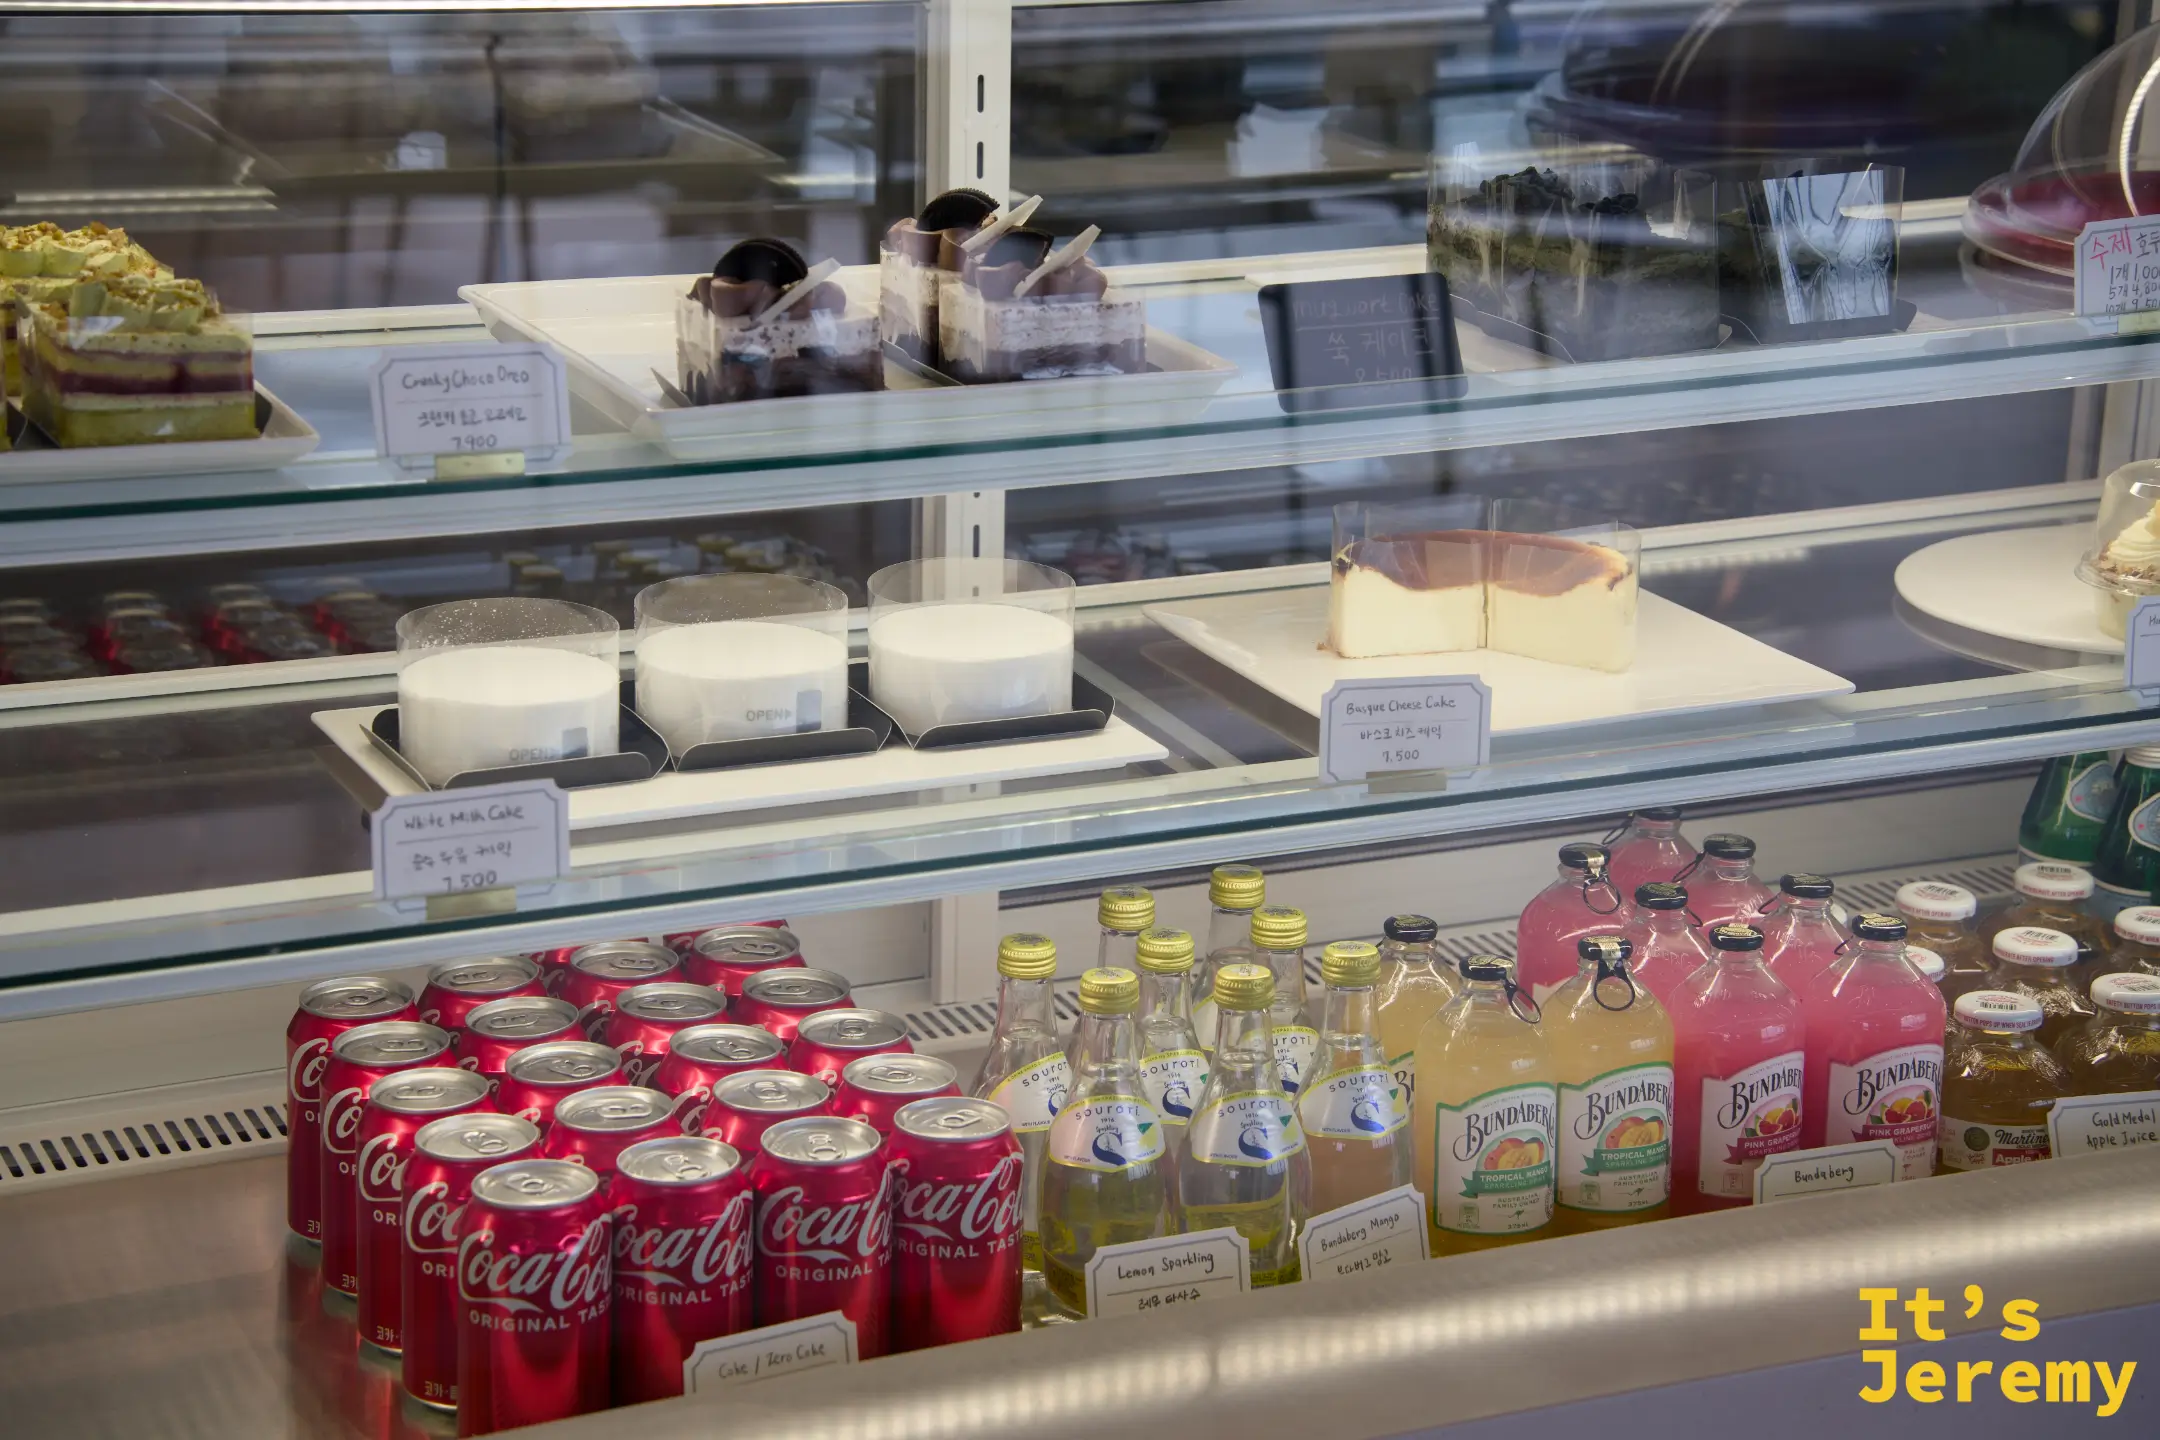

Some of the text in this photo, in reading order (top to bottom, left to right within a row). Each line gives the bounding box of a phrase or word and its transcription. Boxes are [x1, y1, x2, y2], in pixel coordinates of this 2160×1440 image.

[2090, 224, 2132, 271] 수제
[2134, 263, 2160, 282] 1,00
[2132, 281, 2160, 297] 4,80
[1324, 327, 1434, 366] 쑥 케이크
[497, 364, 530, 385] Oreo
[1346, 695, 1456, 716] Basque Cheese Cake
[746, 709, 783, 722] OPEN
[1360, 726, 1393, 741] 바스크
[1395, 726, 1416, 740] 치즈
[1382, 749, 1420, 763] 7.500
[404, 804, 524, 831] White Milk Cake
[1717, 1066, 1803, 1130] BUNDABER
[2091, 1108, 2156, 1128] Gold Medal
[1869, 1128, 1892, 1137] PINK
[2086, 1130, 2159, 1149] Apple Juice
[1744, 1140, 1765, 1149] PINK
[1601, 1152, 1645, 1161] TROPICAL
[1995, 1154, 2032, 1165] Apple
[1480, 1171, 1524, 1183] TROPICAL
[1794, 1164, 1854, 1183] Bundaberg
[1320, 1213, 1400, 1252] Bundaberg Mango
[775, 1263, 873, 1282] ORIGINAL
[1117, 1252, 1214, 1280] Lemon Sparkling
[469, 1309, 571, 1333] ORIGINAL
[718, 1362, 749, 1380] Coke
[767, 1351, 792, 1367] Zero
[795, 1343, 826, 1360] Coke
